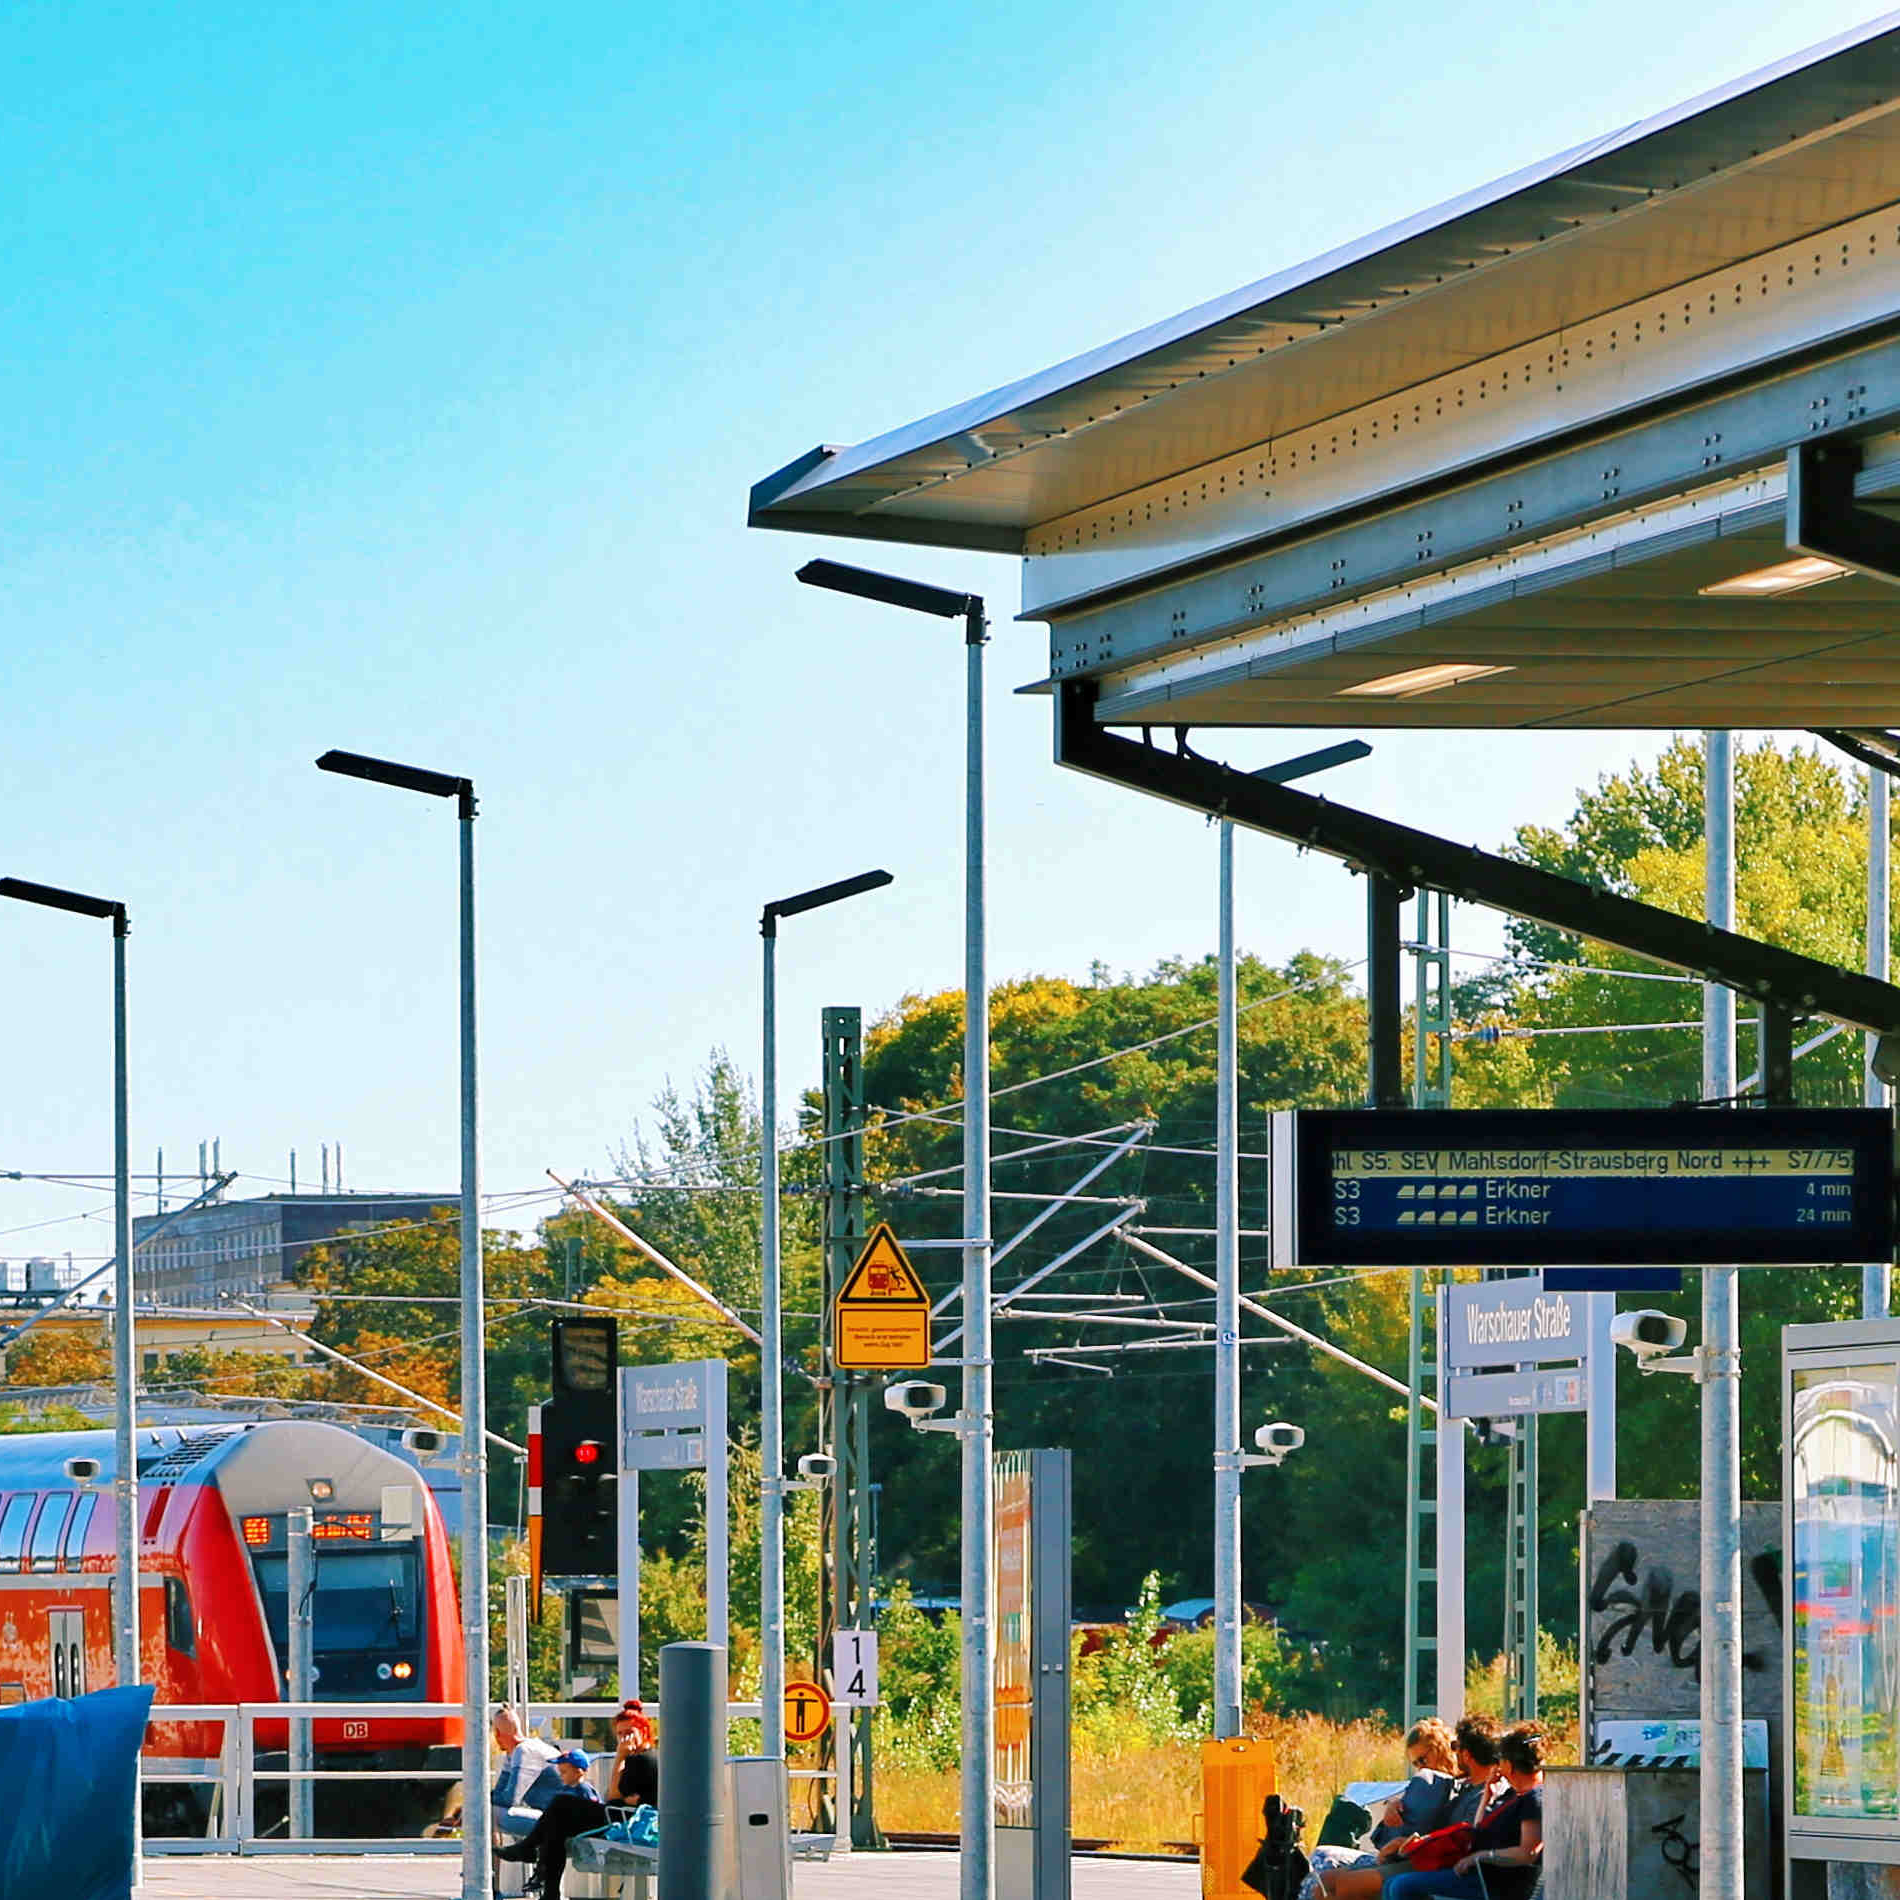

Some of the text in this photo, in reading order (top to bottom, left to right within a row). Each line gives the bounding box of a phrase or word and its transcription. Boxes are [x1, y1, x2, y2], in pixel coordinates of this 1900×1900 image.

[1362, 1153, 1391, 1171] S5:
[1401, 1152, 1438, 1171] SEV
[1450, 1151, 1669, 1173] Mahlsdorf-Strausberg
[1677, 1151, 1723, 1170] Nord
[1788, 1150, 1851, 1169] S7/75
[1334, 1181, 1851, 1199] S3 Erkner 4 min
[1334, 1207, 1851, 1225] S3 Erkner 24 min
[1467, 1295, 1572, 1344] Warschauer Straße
[851, 1636, 860, 1665] 1
[847, 1668, 866, 1698] 4
[345, 1723, 367, 1738] DB
